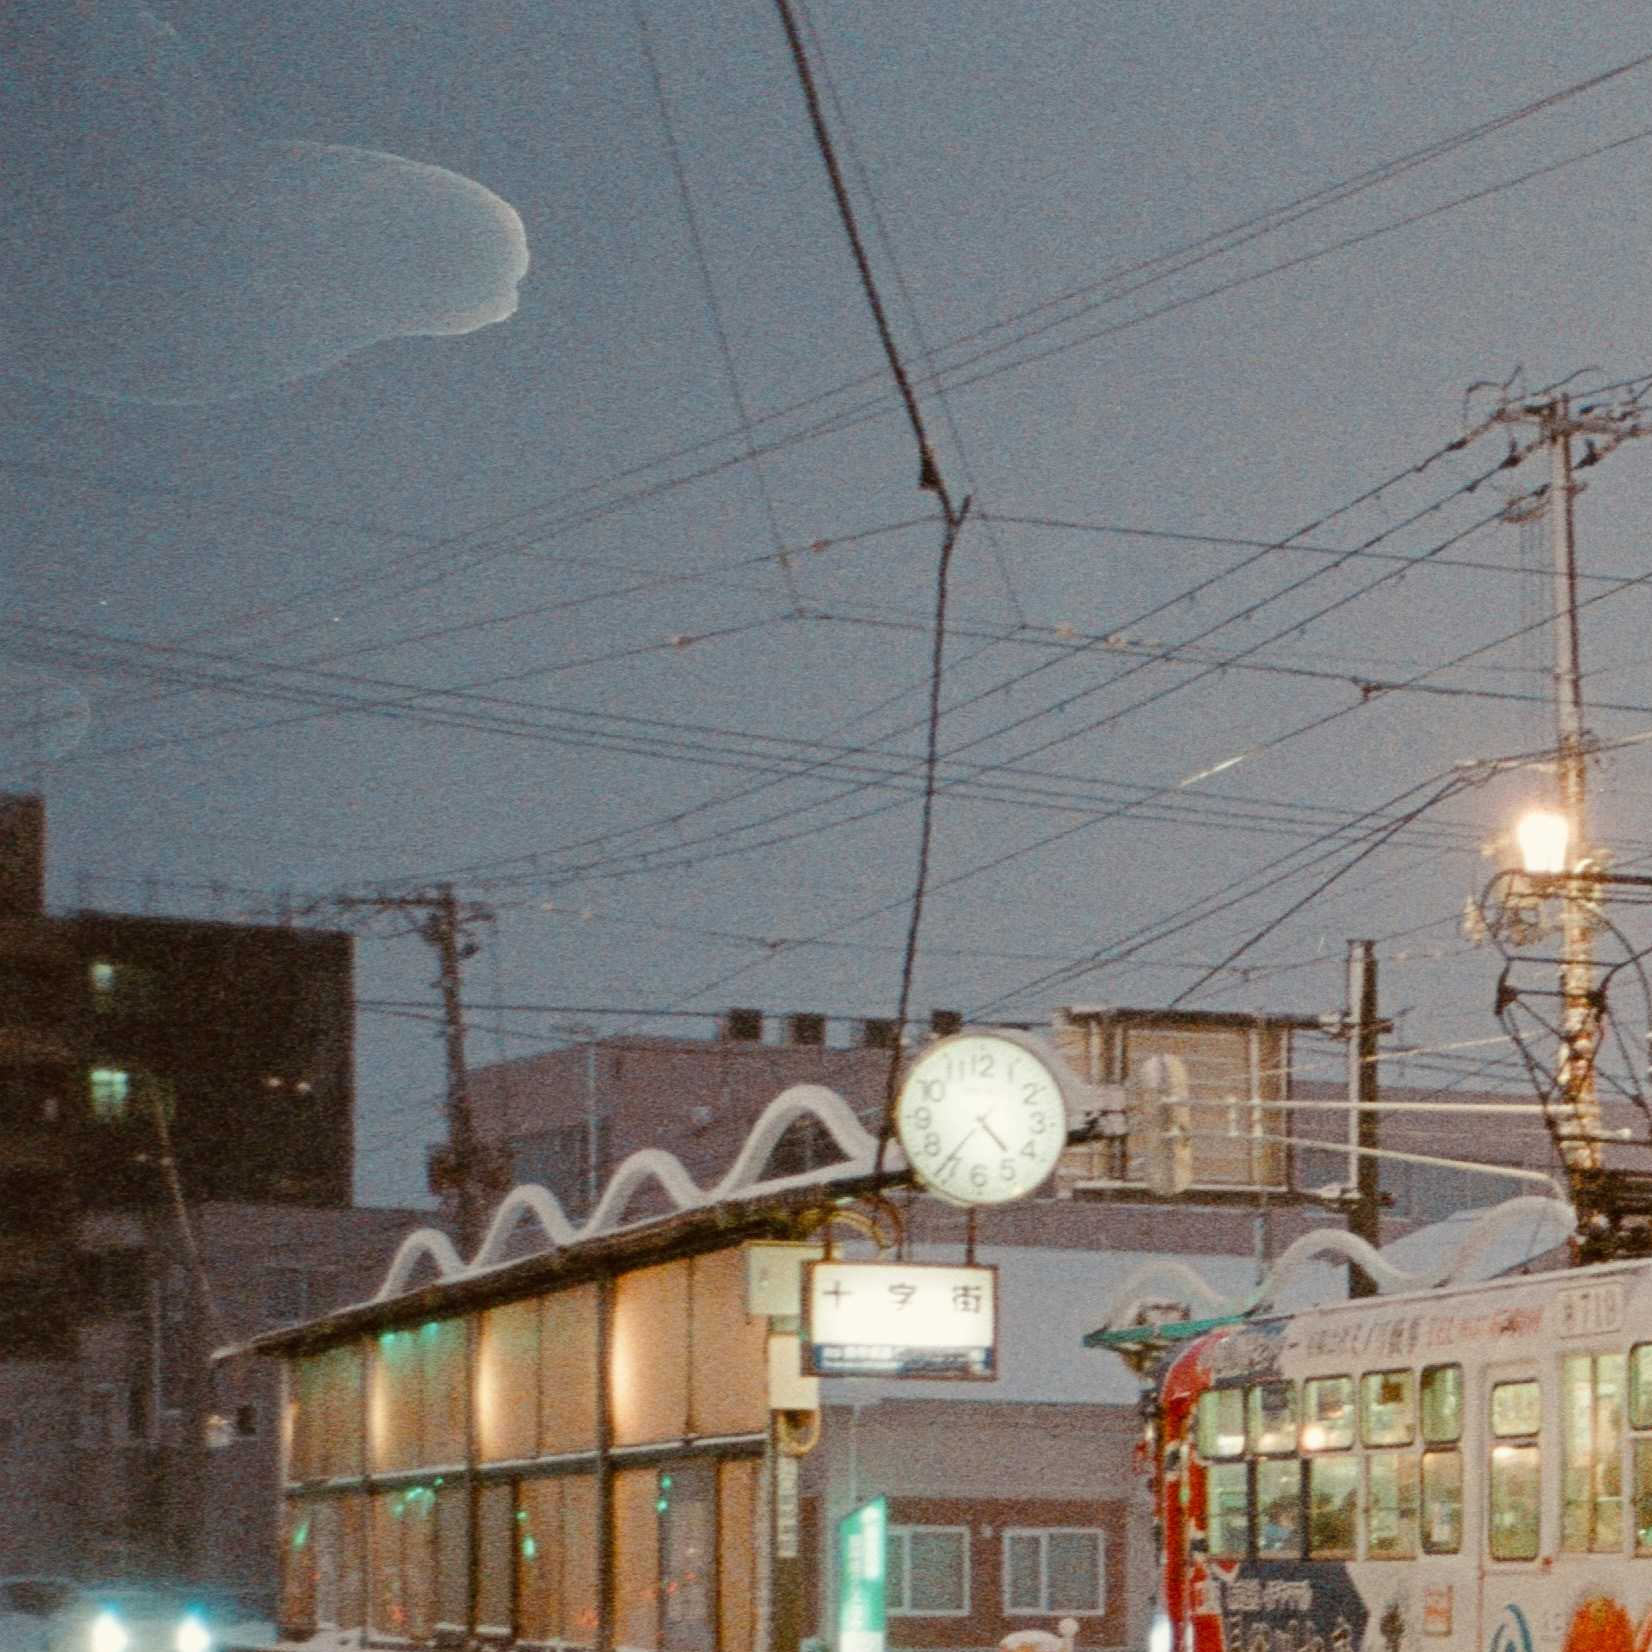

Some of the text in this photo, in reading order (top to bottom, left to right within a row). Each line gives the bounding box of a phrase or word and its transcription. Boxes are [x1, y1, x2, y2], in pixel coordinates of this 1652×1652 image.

[971, 1053, 995, 1079] 12
[913, 1106, 932, 1130] 9
[1029, 1111, 1045, 1135] 3
[923, 1131, 942, 1157] 8
[1020, 1138, 1037, 1160] 4
[969, 1163, 989, 1188] 6
[1000, 1157, 1017, 1182] 5
[822, 1279, 982, 1314] 十字街
